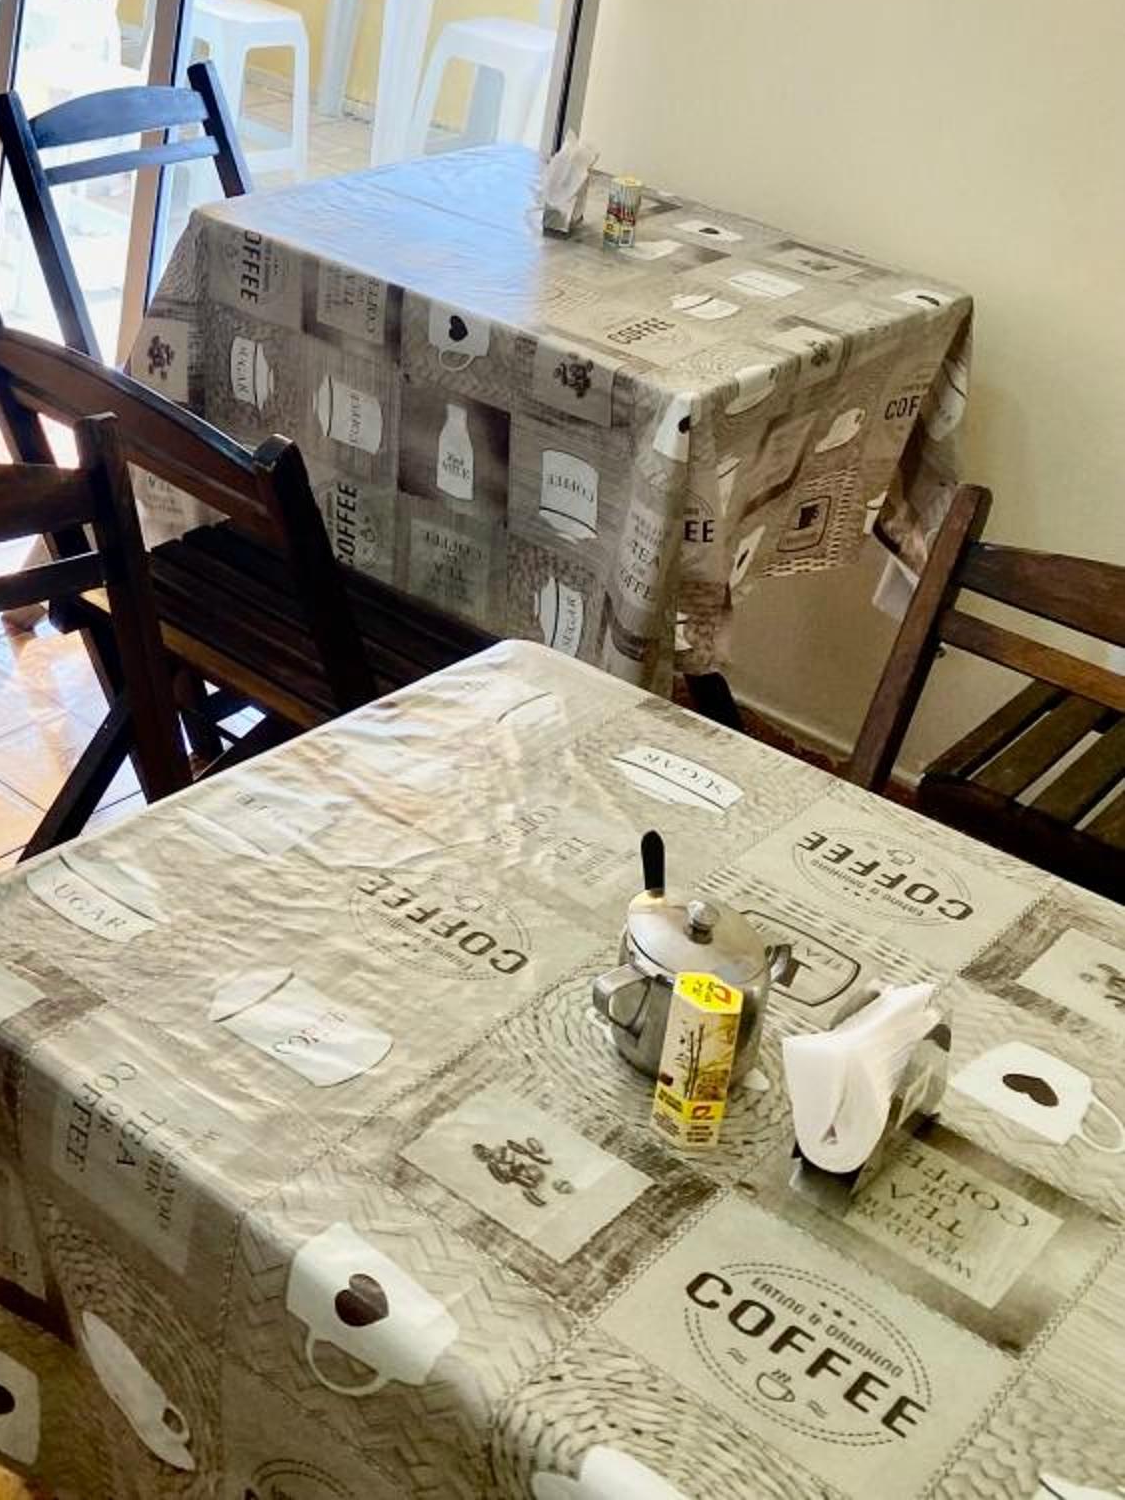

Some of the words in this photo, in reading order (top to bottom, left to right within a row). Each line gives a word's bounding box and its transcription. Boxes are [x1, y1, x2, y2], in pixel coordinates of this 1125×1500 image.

[607, 317, 676, 345] COFFEE
[642, 753, 723, 798] SUGAR
[797, 831, 973, 920] COFFEE
[357, 873, 528, 974] COFFEE
[890, 1183, 964, 1240] TEA
[686, 1272, 927, 1439] COFFEE
